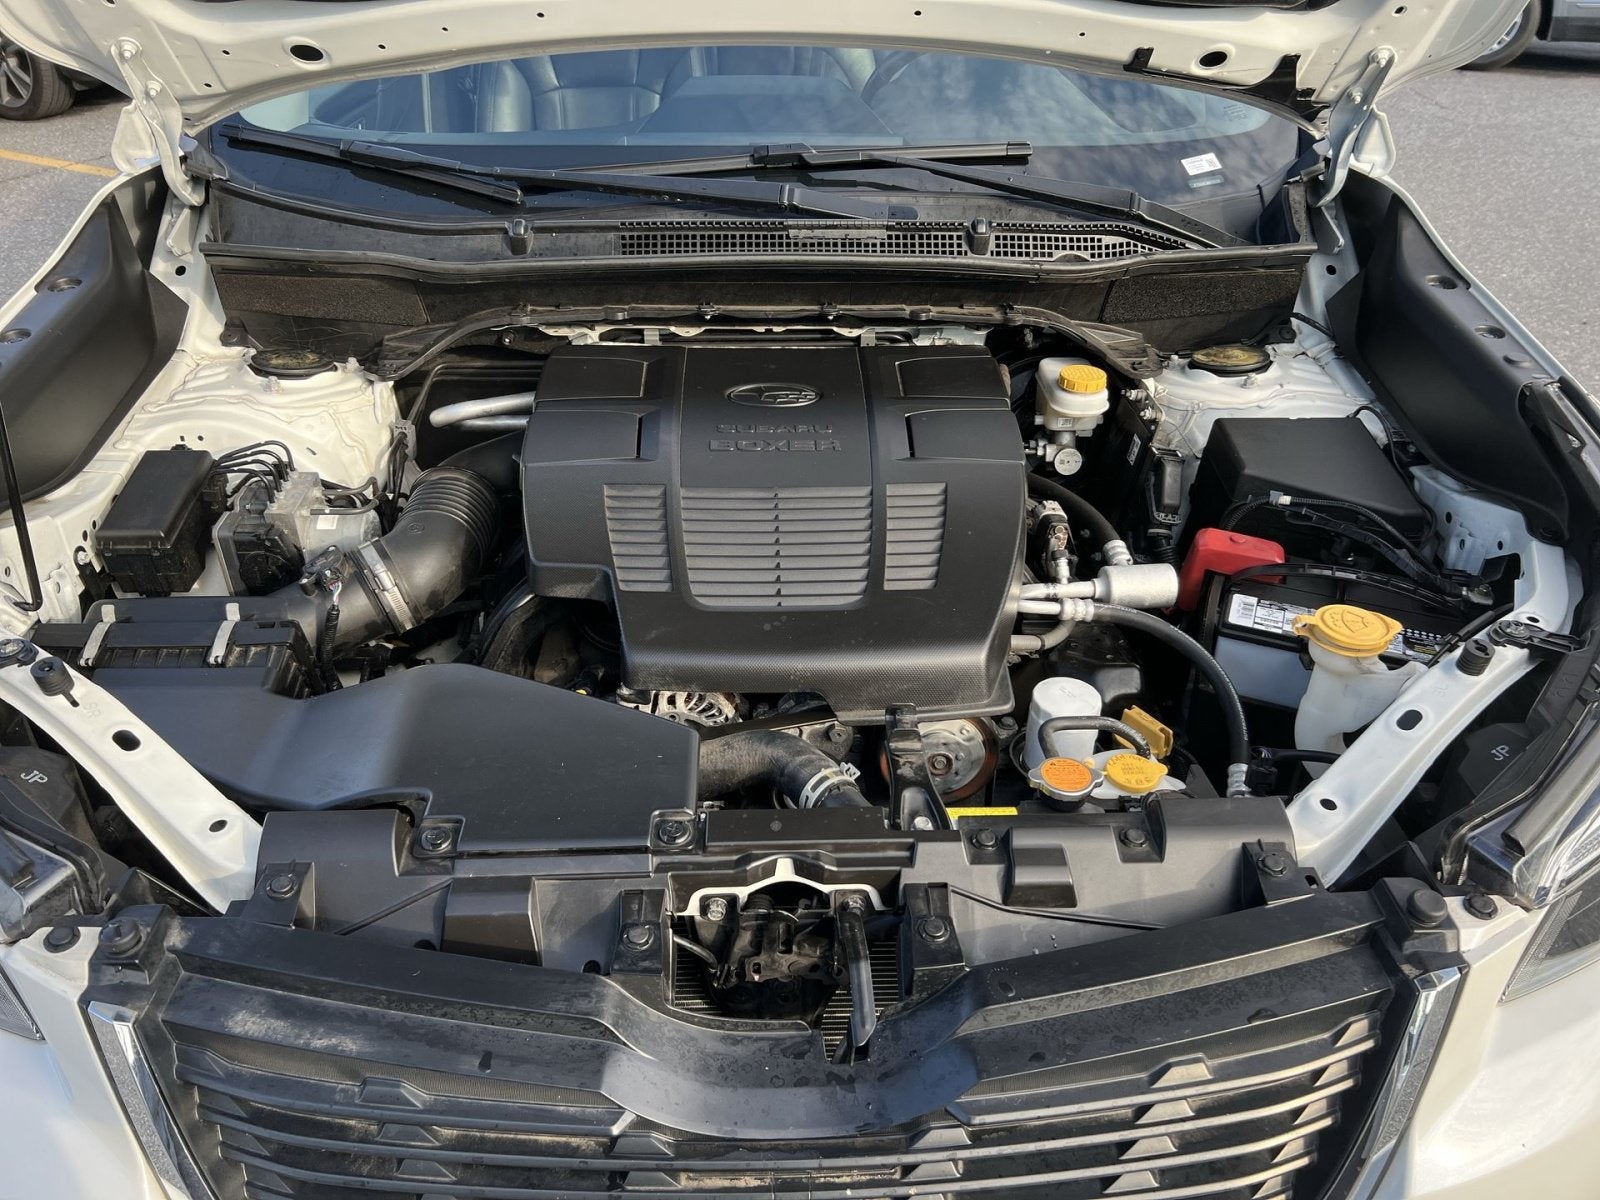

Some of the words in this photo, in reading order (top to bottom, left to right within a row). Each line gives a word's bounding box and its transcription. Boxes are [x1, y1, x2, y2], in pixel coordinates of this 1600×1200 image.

[715, 424, 833, 434] SUBARU
[709, 439, 842, 451] BOXER
[1491, 745, 1509, 760] JP
[20, 770, 48, 783] JP
